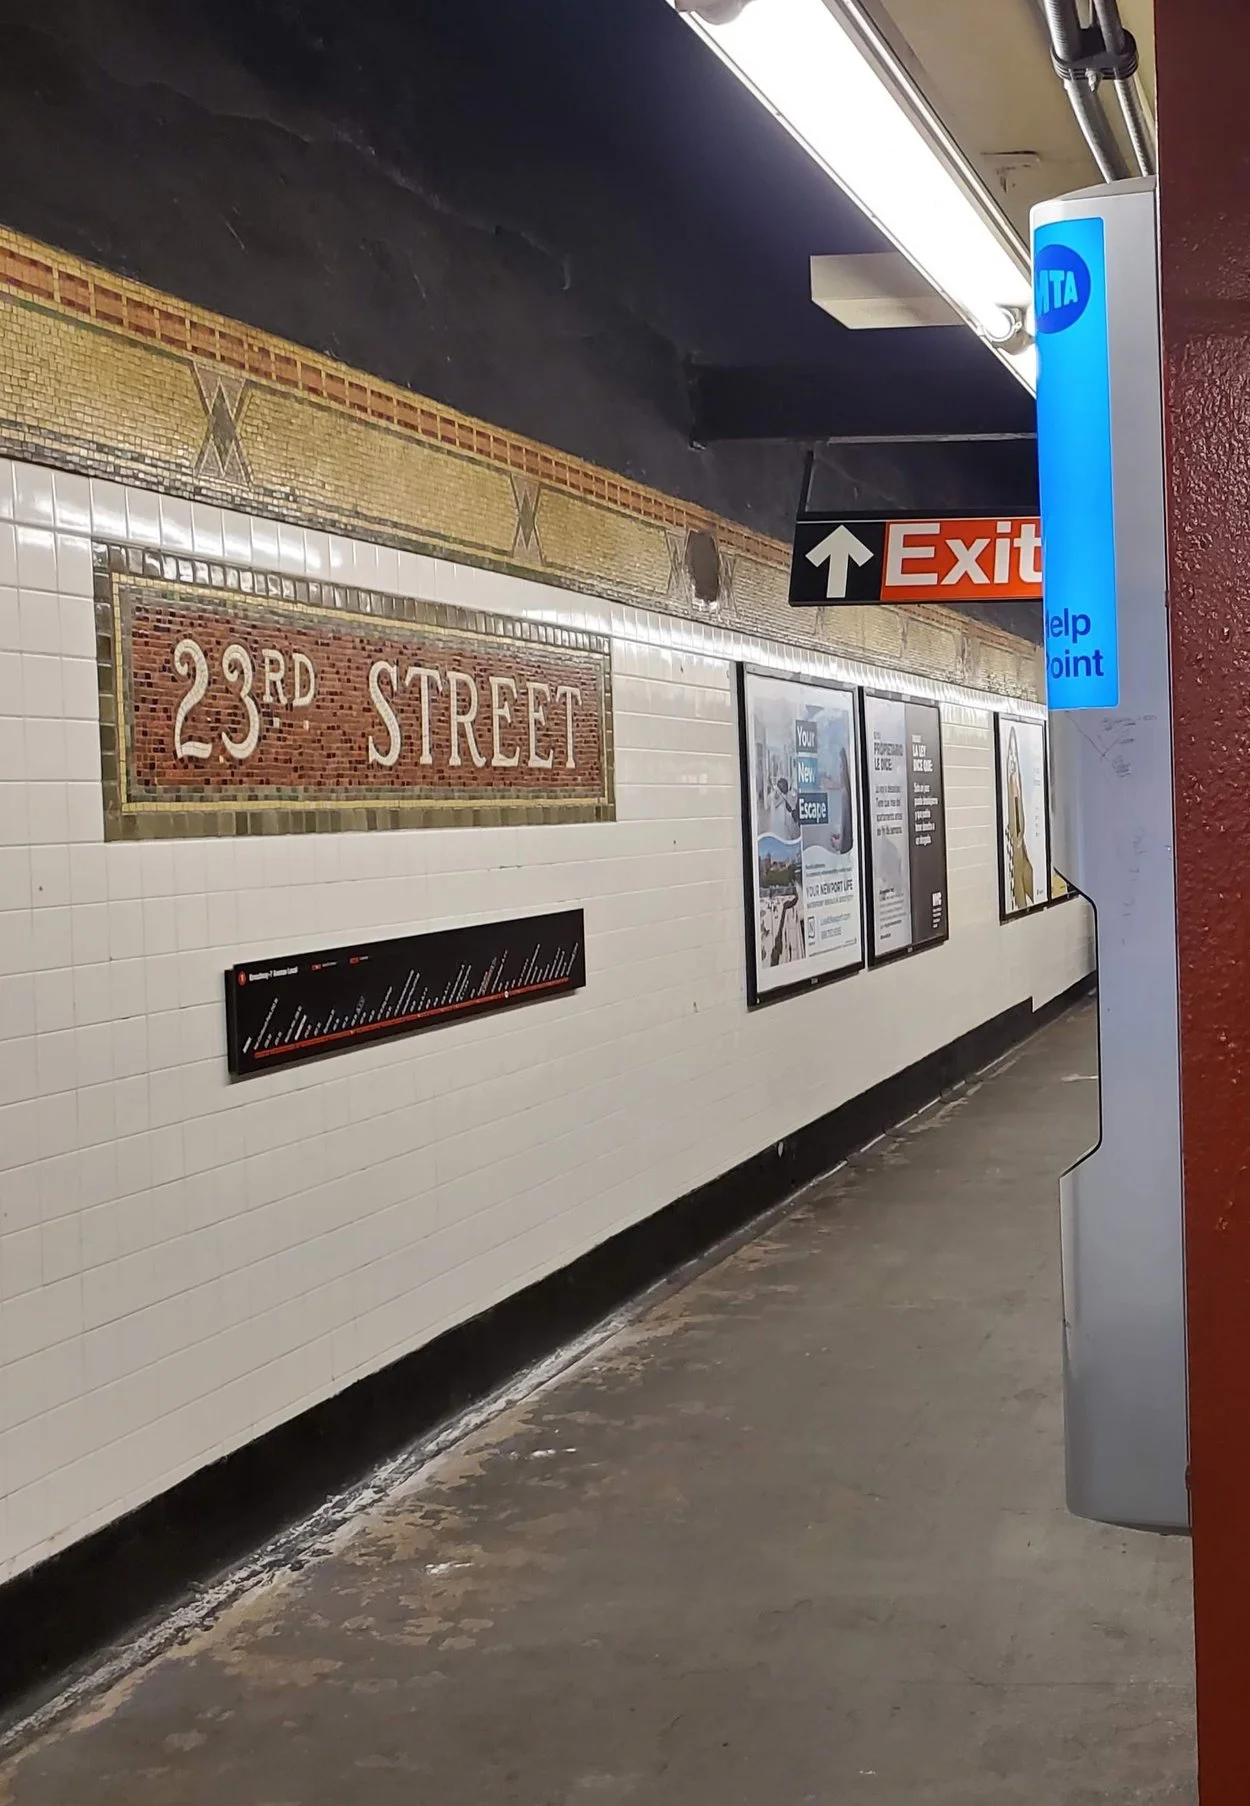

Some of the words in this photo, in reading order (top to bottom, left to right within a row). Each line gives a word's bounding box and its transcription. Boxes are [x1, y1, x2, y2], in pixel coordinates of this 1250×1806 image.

[885, 519, 1043, 587] Exit
[1046, 649, 1105, 679] oint
[173, 638, 316, 761] 23RD
[367, 658, 583, 770] STREET
[797, 725, 815, 747] Your
[799, 798, 827, 823] Escape
